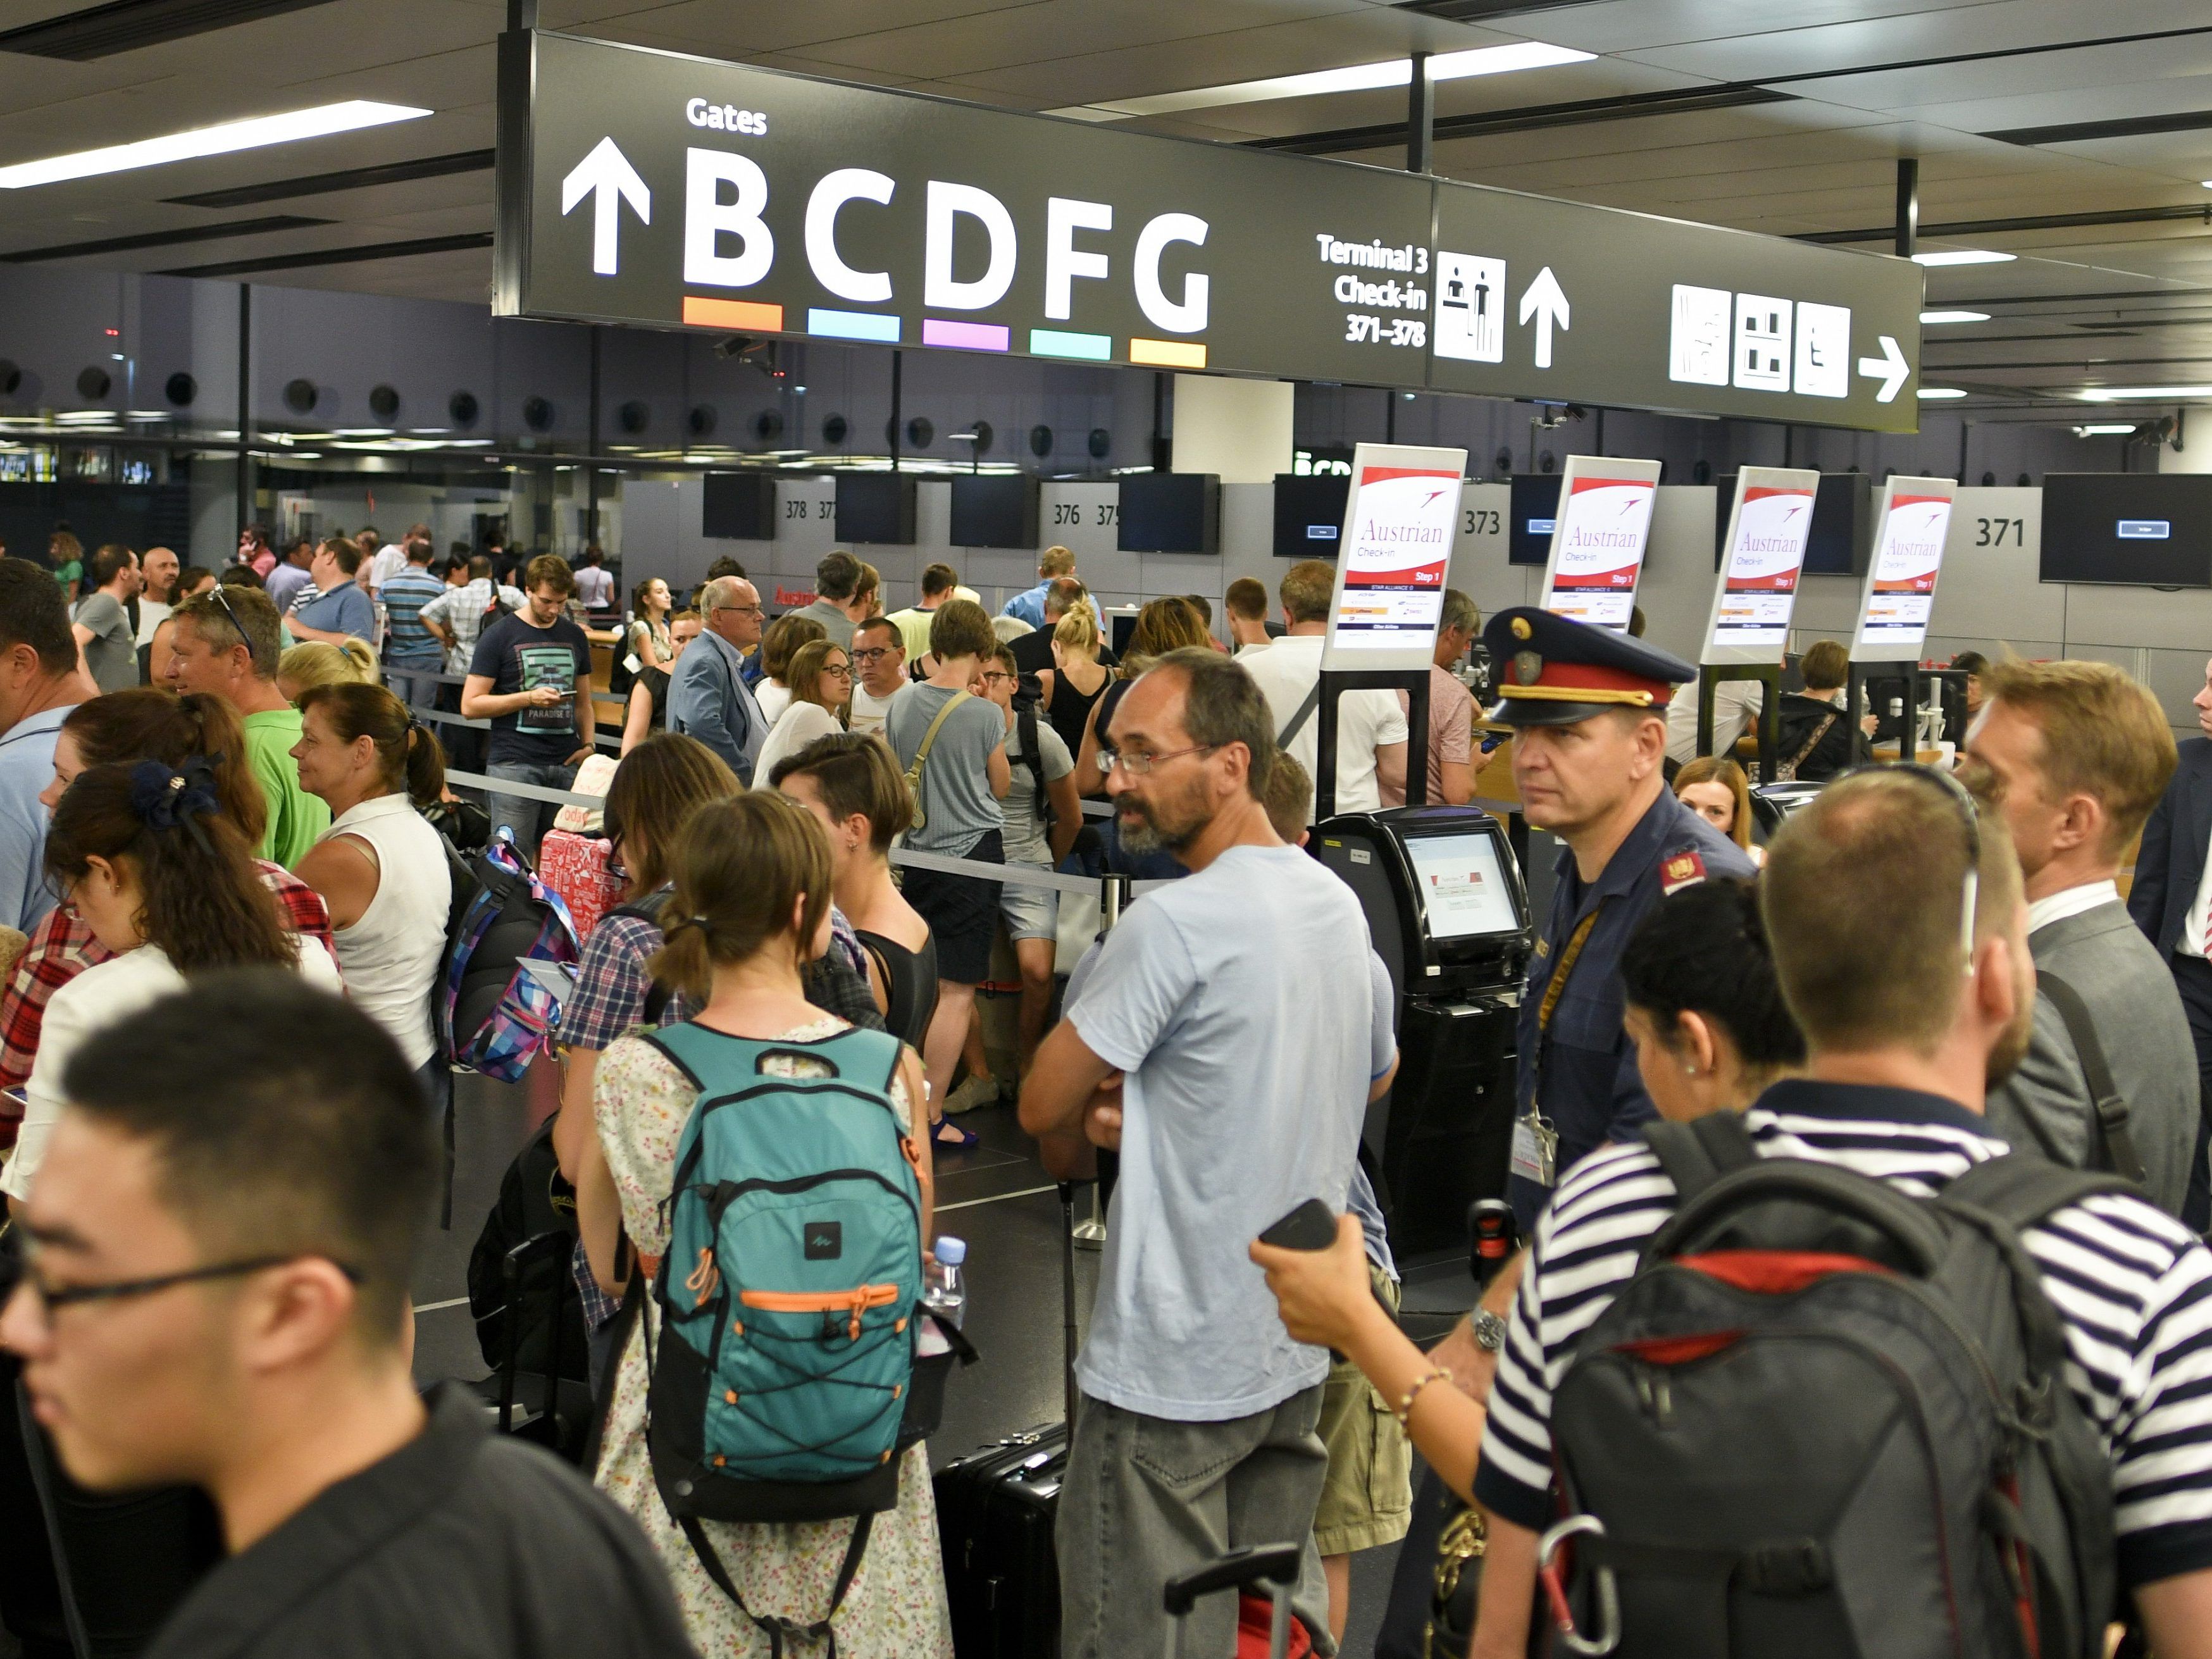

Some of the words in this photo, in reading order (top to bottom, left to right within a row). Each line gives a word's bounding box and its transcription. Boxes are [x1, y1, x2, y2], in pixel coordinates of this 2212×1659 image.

[687, 97, 767, 135] Gates
[684, 147, 774, 287] B
[805, 168, 896, 302] C
[924, 180, 1017, 309] D
[1045, 197, 1112, 320] F
[1134, 213, 1209, 333] G
[1316, 233, 1413, 271] Terminal
[1415, 247, 1428, 274] 3
[1334, 275, 1427, 310] Check-in
[786, 500, 807, 518] 378
[1054, 504, 1080, 525] 376
[1360, 518, 1442, 543] Austrian
[1464, 510, 1500, 535] 373
[1975, 518, 2024, 547] 371
[1569, 526, 1637, 547] Austrian
[1740, 531, 1798, 552] Austrian
[1886, 537, 1937, 556] Austrian
[1357, 547, 1395, 557] Check-in
[1565, 552, 1597, 562] Check-in
[1415, 571, 1433, 583] Step
[1434, 572, 1439, 581] 1
[1612, 575, 1627, 585] Step
